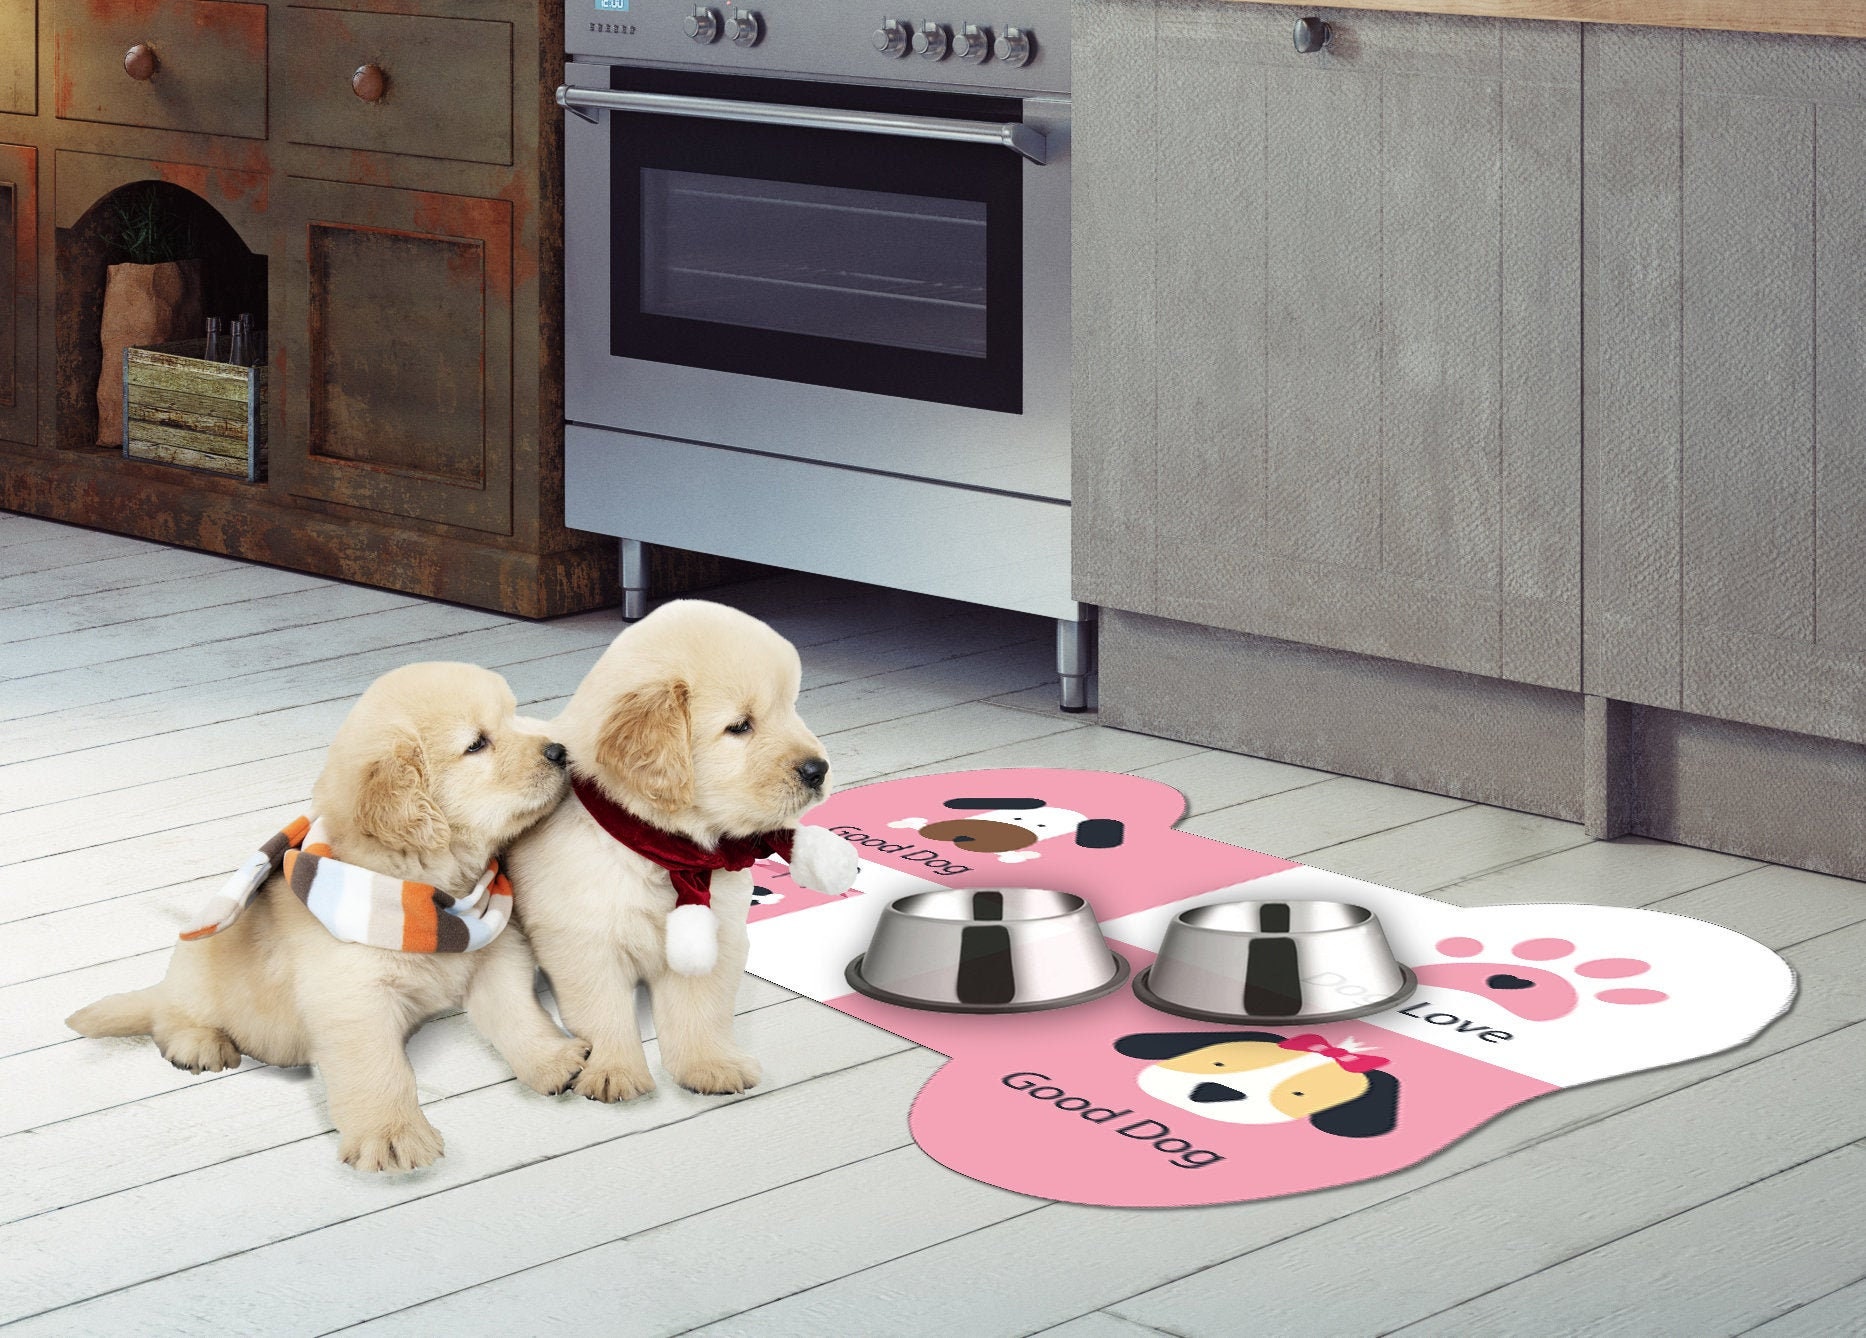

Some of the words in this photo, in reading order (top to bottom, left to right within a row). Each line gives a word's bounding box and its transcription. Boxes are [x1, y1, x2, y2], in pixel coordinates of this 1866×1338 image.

[900, 849, 974, 876] Dog
[1397, 1001, 1514, 1044] Love
[1000, 1071, 1134, 1124] Good
[1115, 1118, 1227, 1169] Dog
